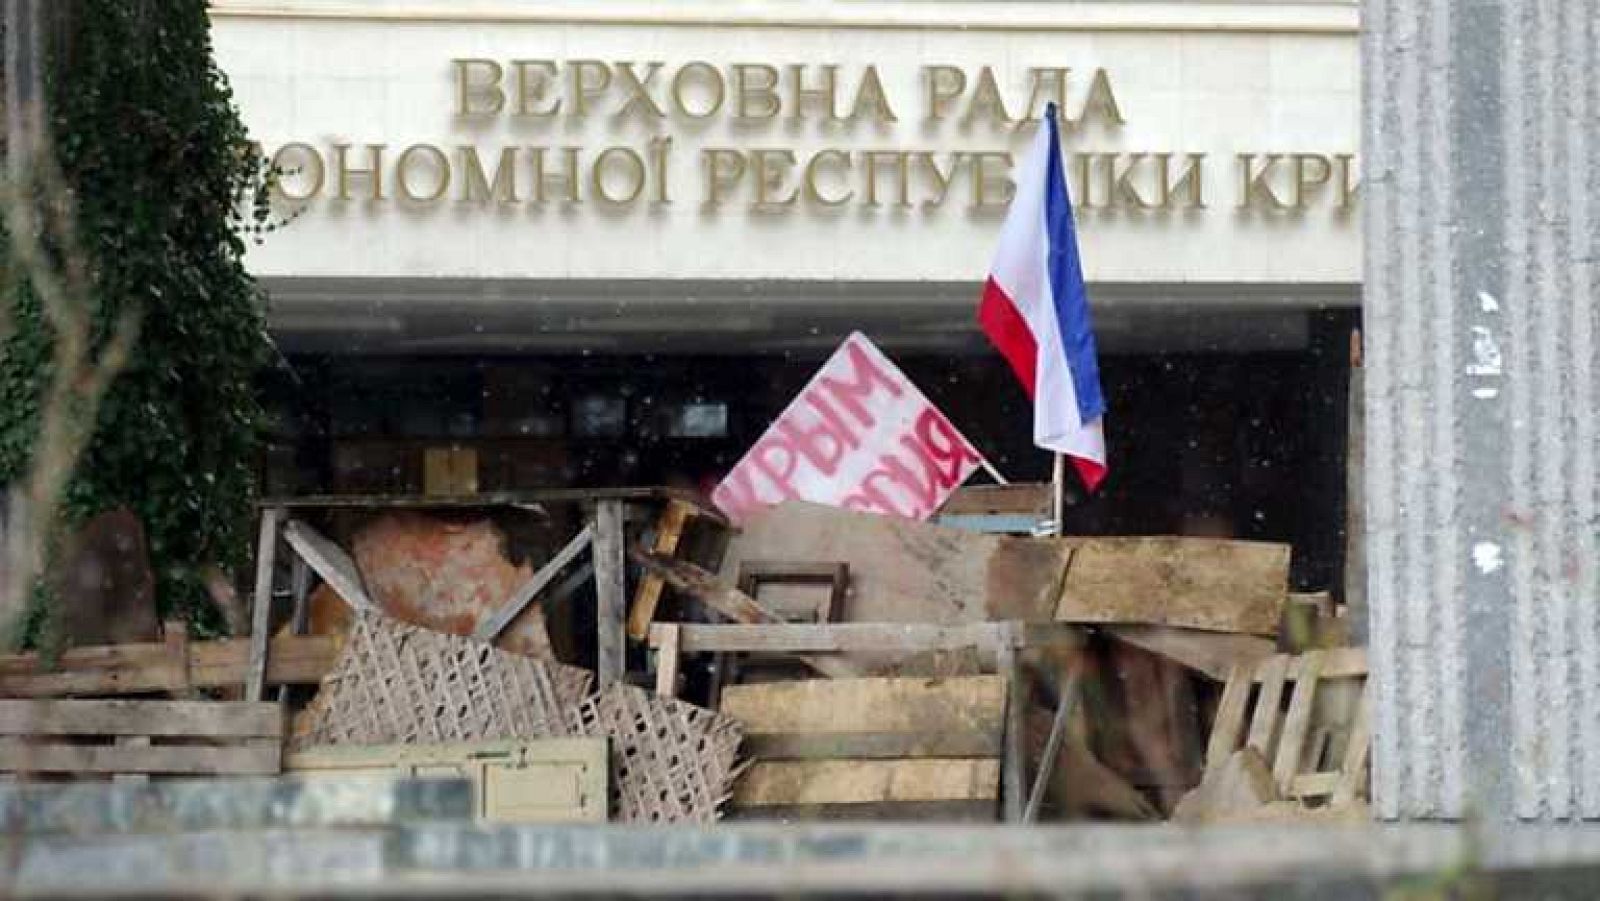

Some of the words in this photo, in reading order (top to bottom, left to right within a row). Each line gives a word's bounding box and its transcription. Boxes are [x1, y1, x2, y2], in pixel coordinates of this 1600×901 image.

[451, 58, 898, 125] ВЕРХОВНА
[923, 64, 1127, 130] РАДА
[232, 135, 674, 207] ОНОМНОЇ
[702, 148, 1208, 210] РЕСПУБІКИ
[843, 407, 981, 518] СИЯ
